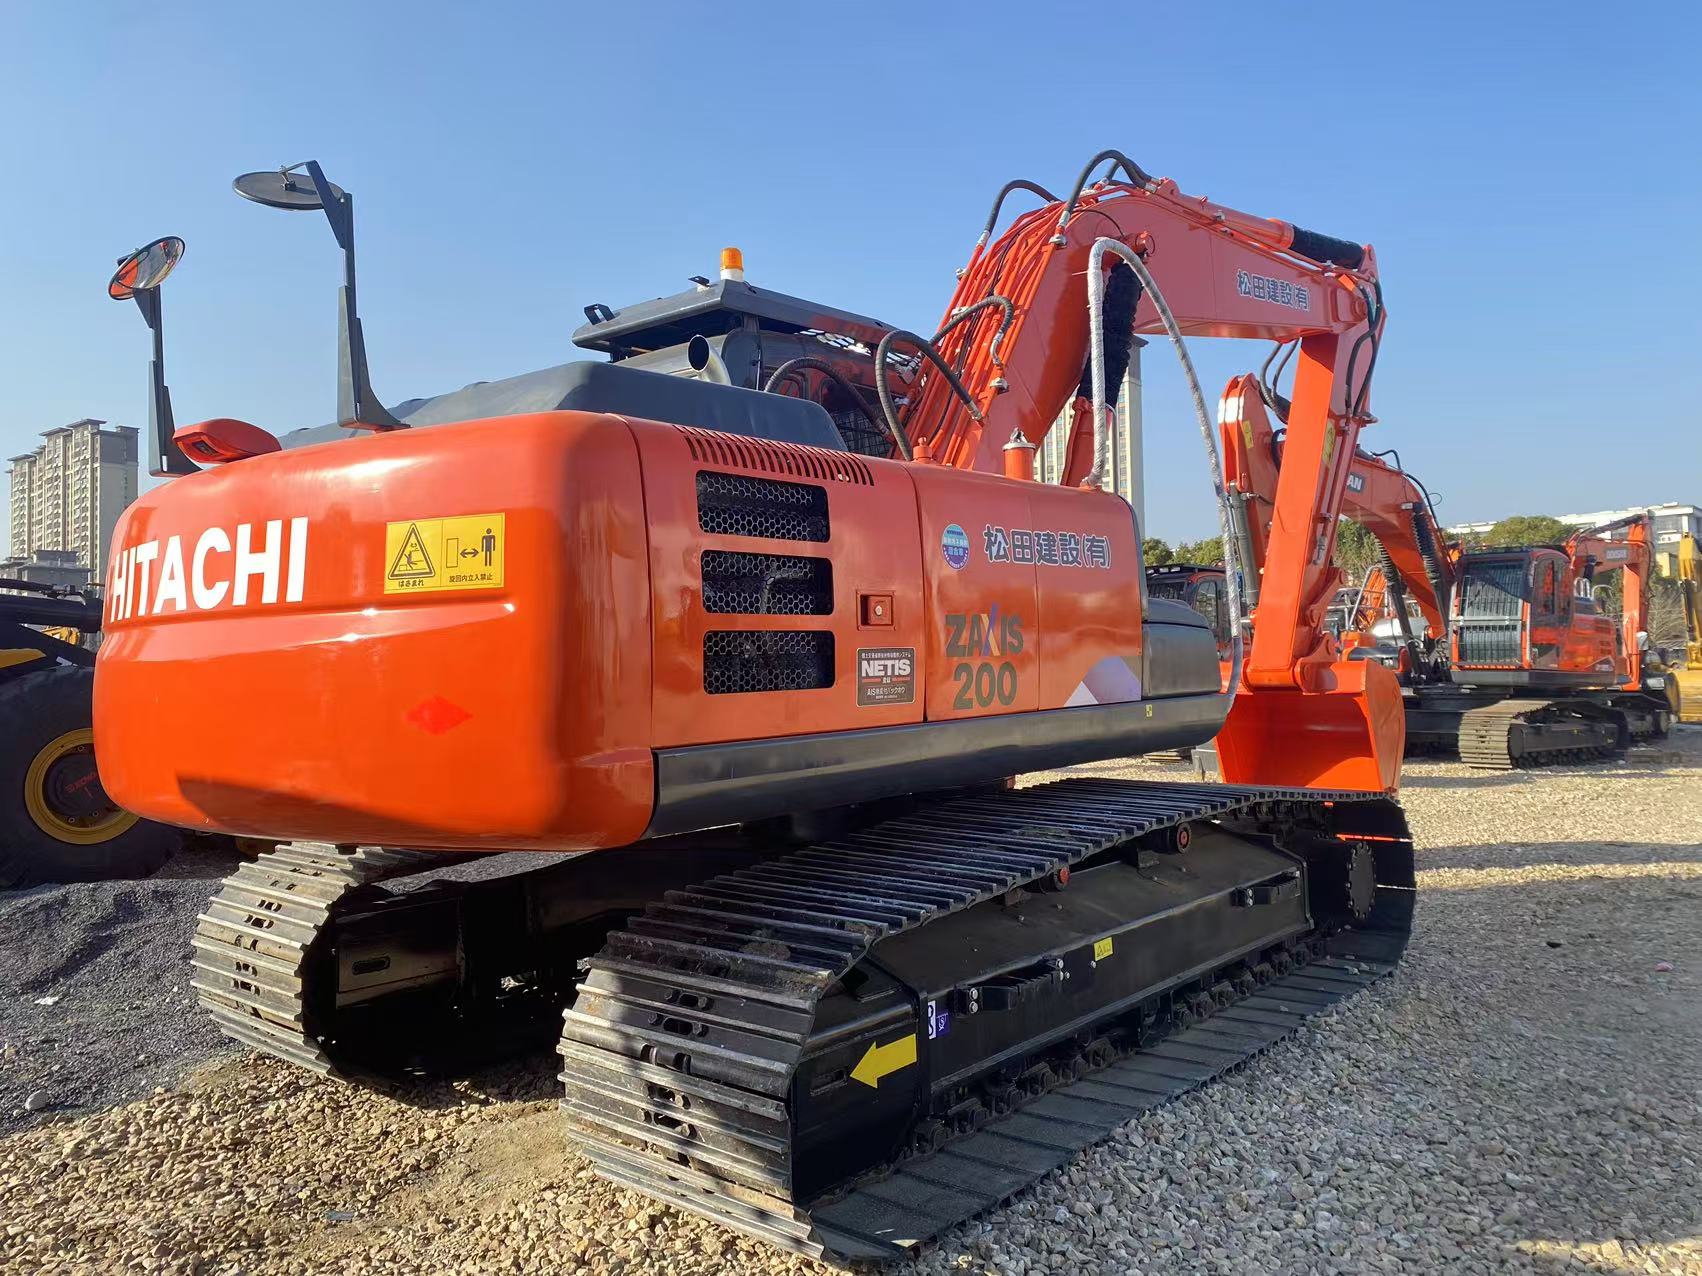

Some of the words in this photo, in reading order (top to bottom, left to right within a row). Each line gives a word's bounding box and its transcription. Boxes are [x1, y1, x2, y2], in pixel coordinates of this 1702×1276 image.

[110, 516, 309, 624] HITACHI
[398, 579, 424, 588] はさまれ
[945, 601, 1024, 657] ZAXIS
[861, 659, 911, 677] NETIS
[953, 661, 1017, 710] 200
